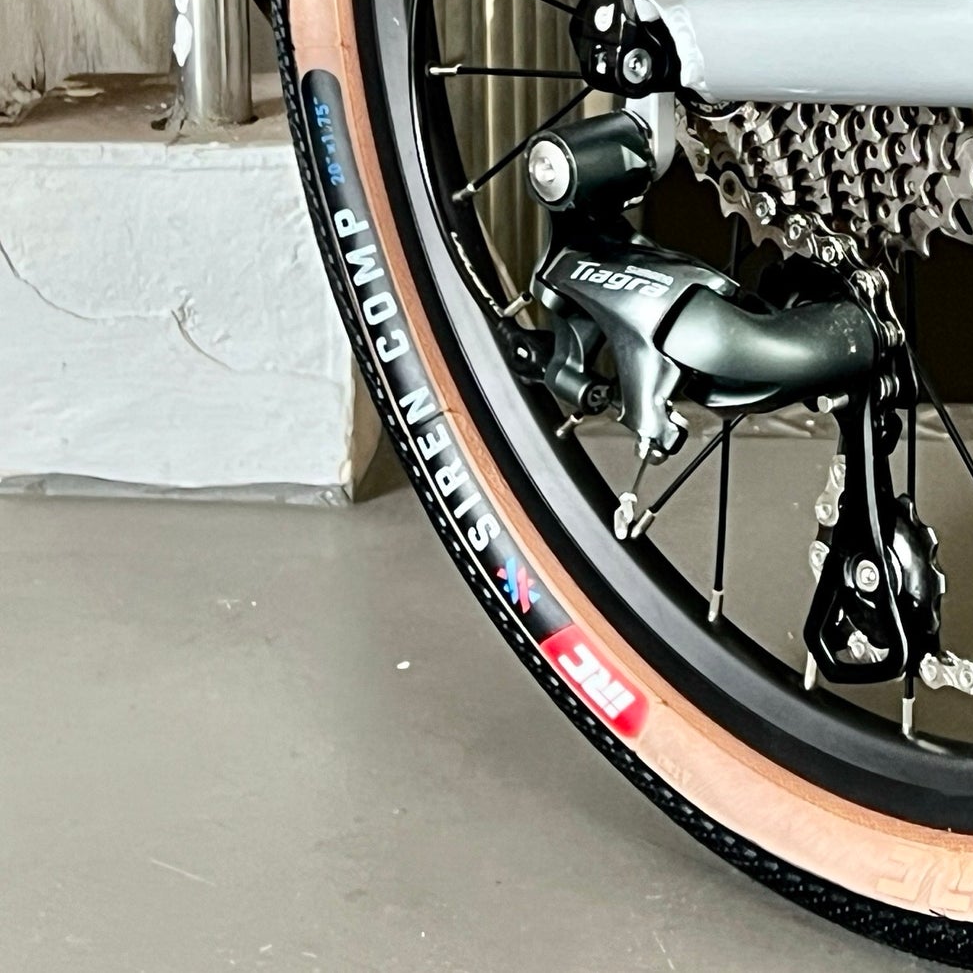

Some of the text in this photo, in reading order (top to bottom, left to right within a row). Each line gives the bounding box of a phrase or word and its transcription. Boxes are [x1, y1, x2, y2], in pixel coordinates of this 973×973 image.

[334, 208, 411, 363] COMP
[570, 260, 670, 298] Tiagra
[399, 386, 501, 552] SIREN
